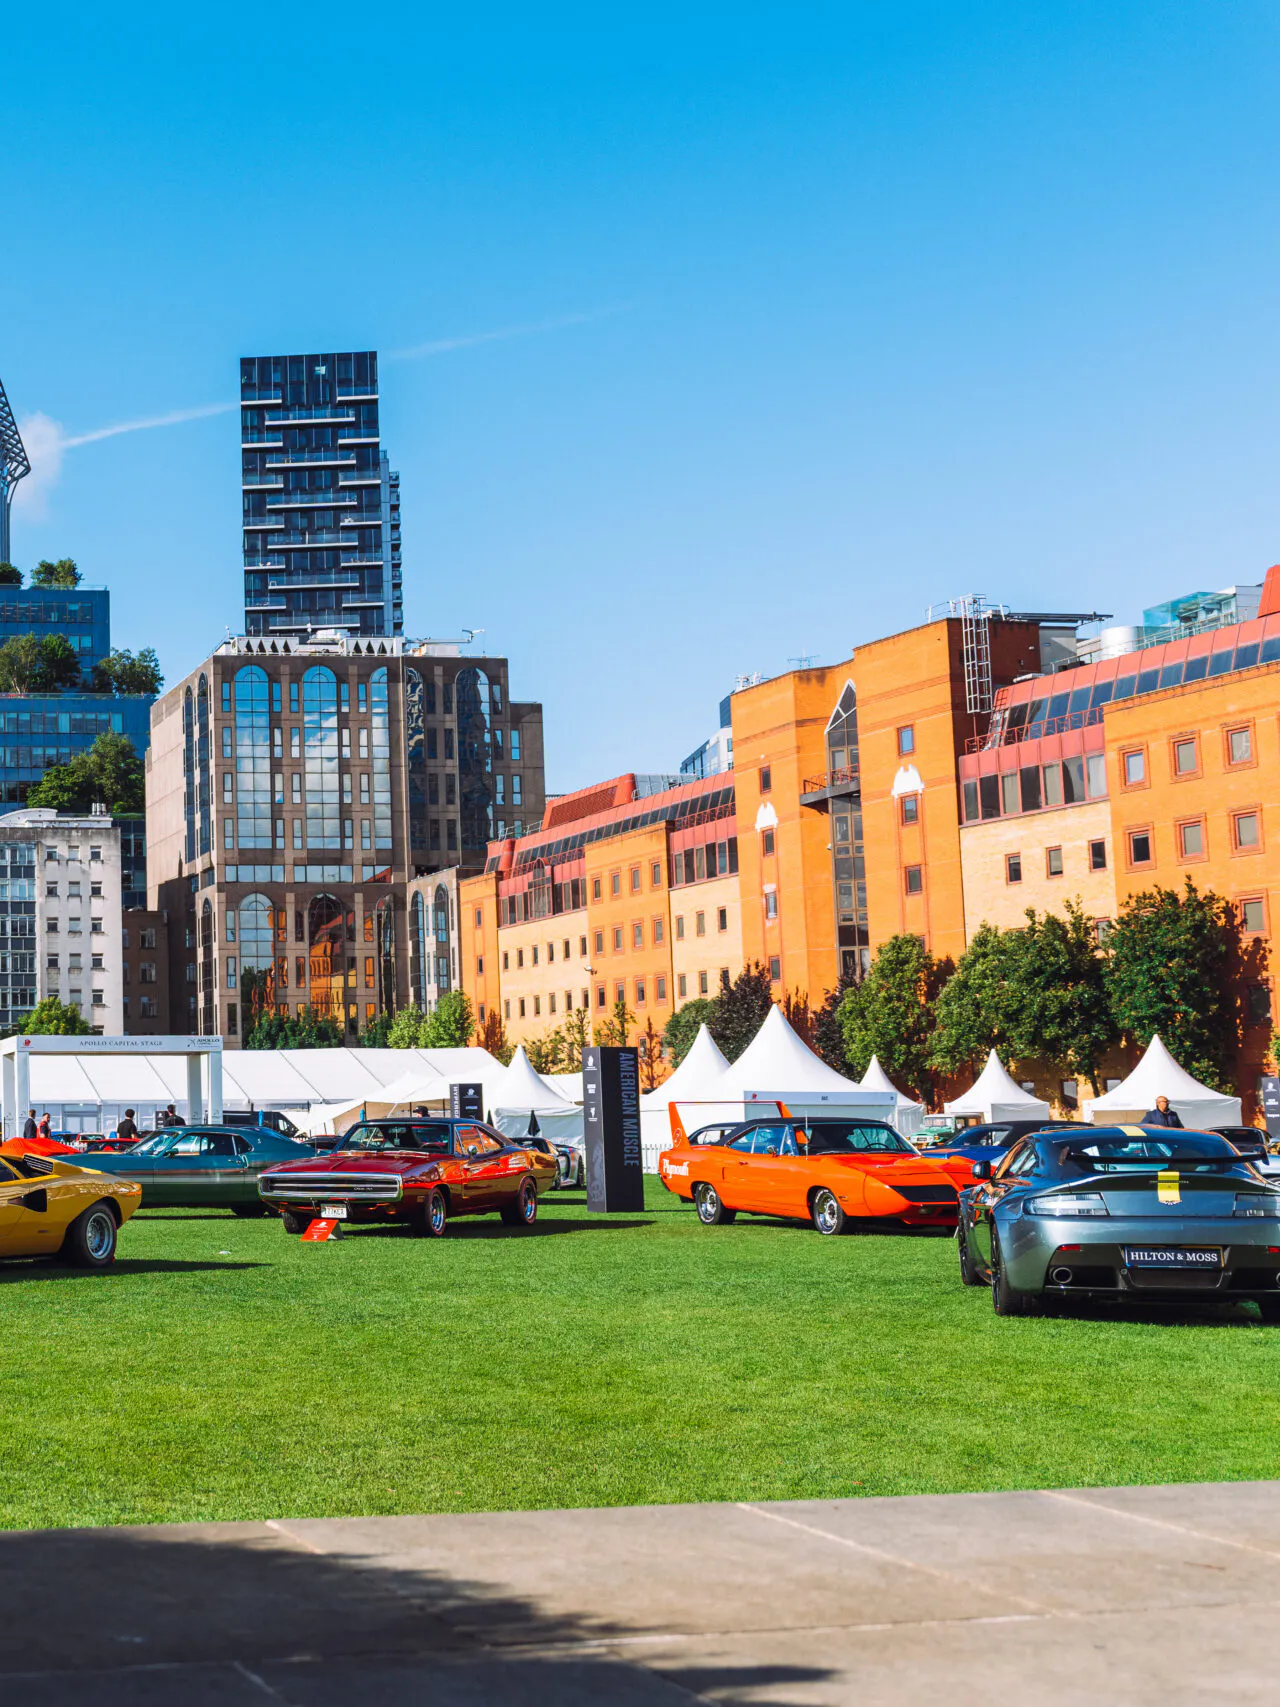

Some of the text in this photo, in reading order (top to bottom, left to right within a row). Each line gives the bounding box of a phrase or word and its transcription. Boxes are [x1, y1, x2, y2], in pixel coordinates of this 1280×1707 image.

[619, 1052, 640, 1166] AMERICAN MUSCLE
[662, 1158, 690, 1179] Plymouth
[1130, 1251, 1218, 1262] HILTON & MOSS
